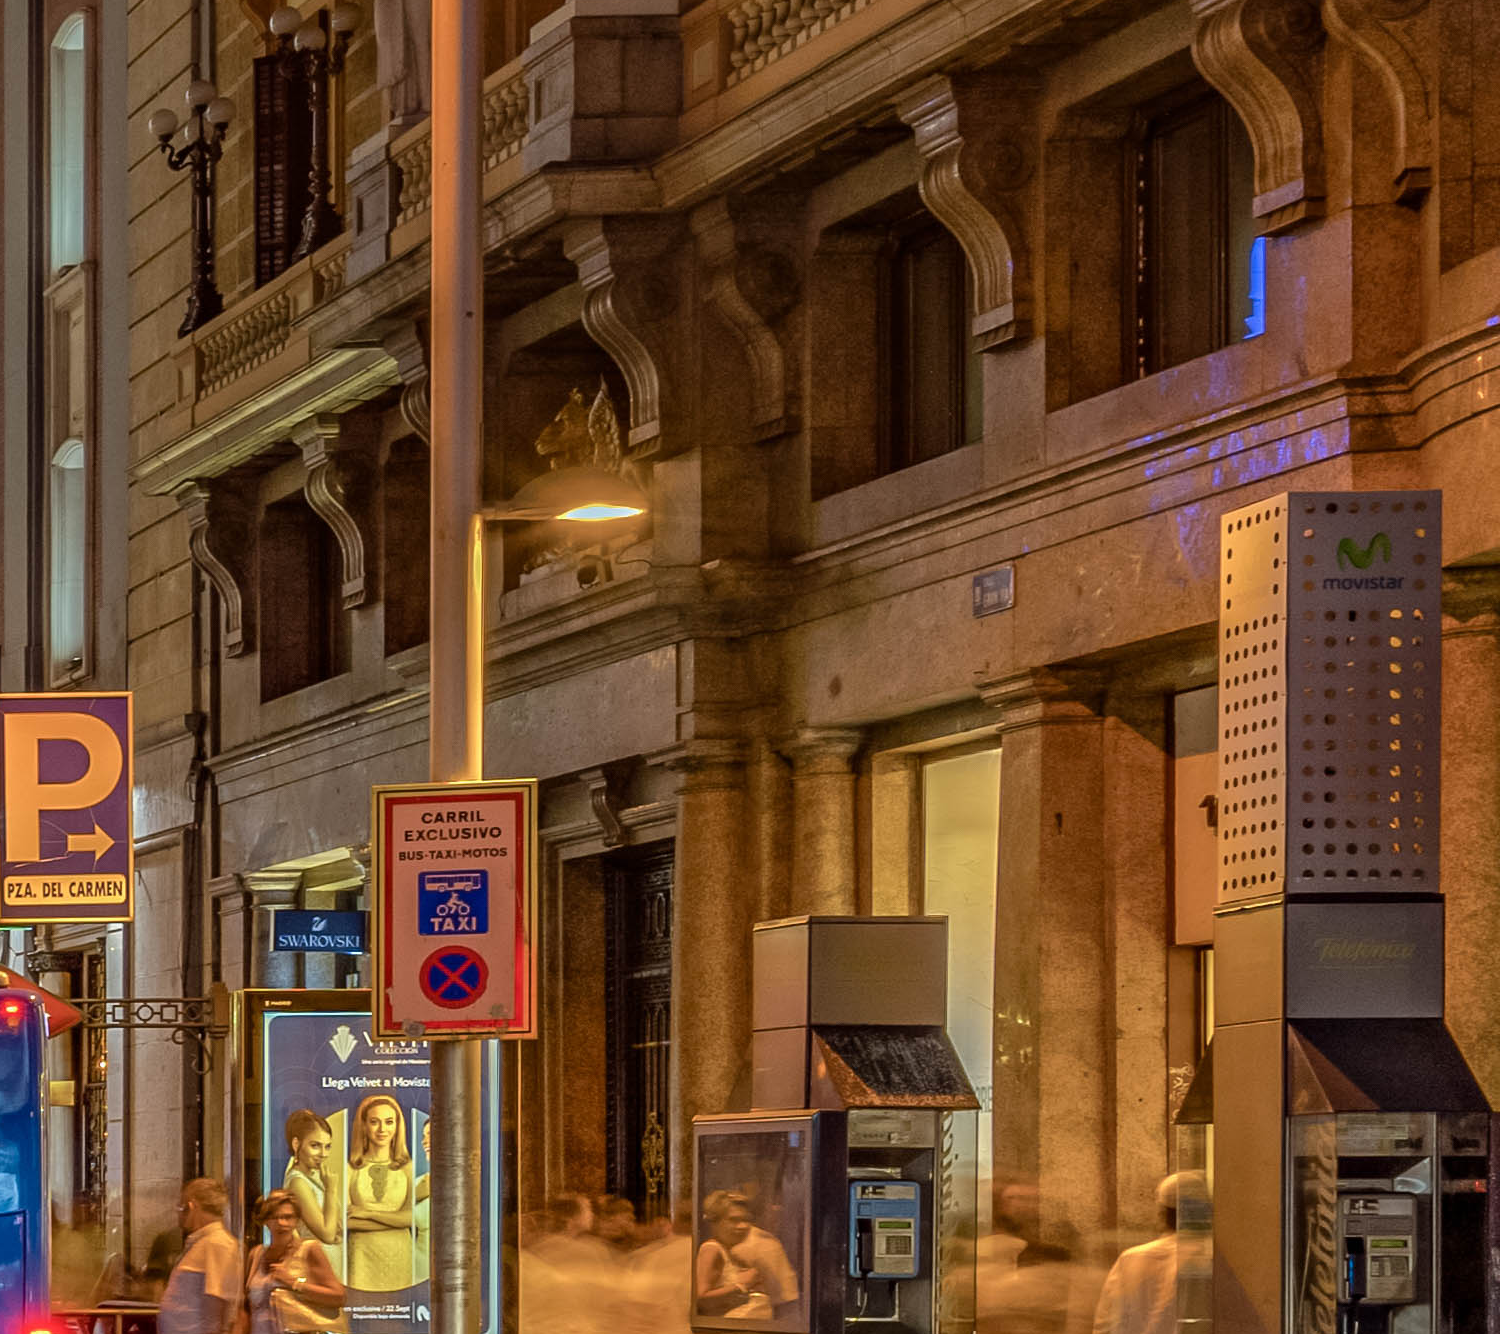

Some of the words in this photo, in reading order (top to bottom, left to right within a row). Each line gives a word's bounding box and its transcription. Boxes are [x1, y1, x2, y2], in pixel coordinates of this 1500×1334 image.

[1323, 575, 1405, 590] movistar
[4, 712, 123, 862] P
[421, 810, 485, 824] CARRIL
[404, 827, 502, 842] EXCLUSIVO
[7, 882, 37, 898] PZA.
[42, 882, 63, 898] DEL
[69, 881, 123, 897] CARMEN
[430, 917, 477, 932] TAXI
[278, 934, 361, 948] SWAROVSKI
[322, 1077, 349, 1091] Llega
[351, 1077, 381, 1088] Velvet
[384, 1080, 391, 1088] a
